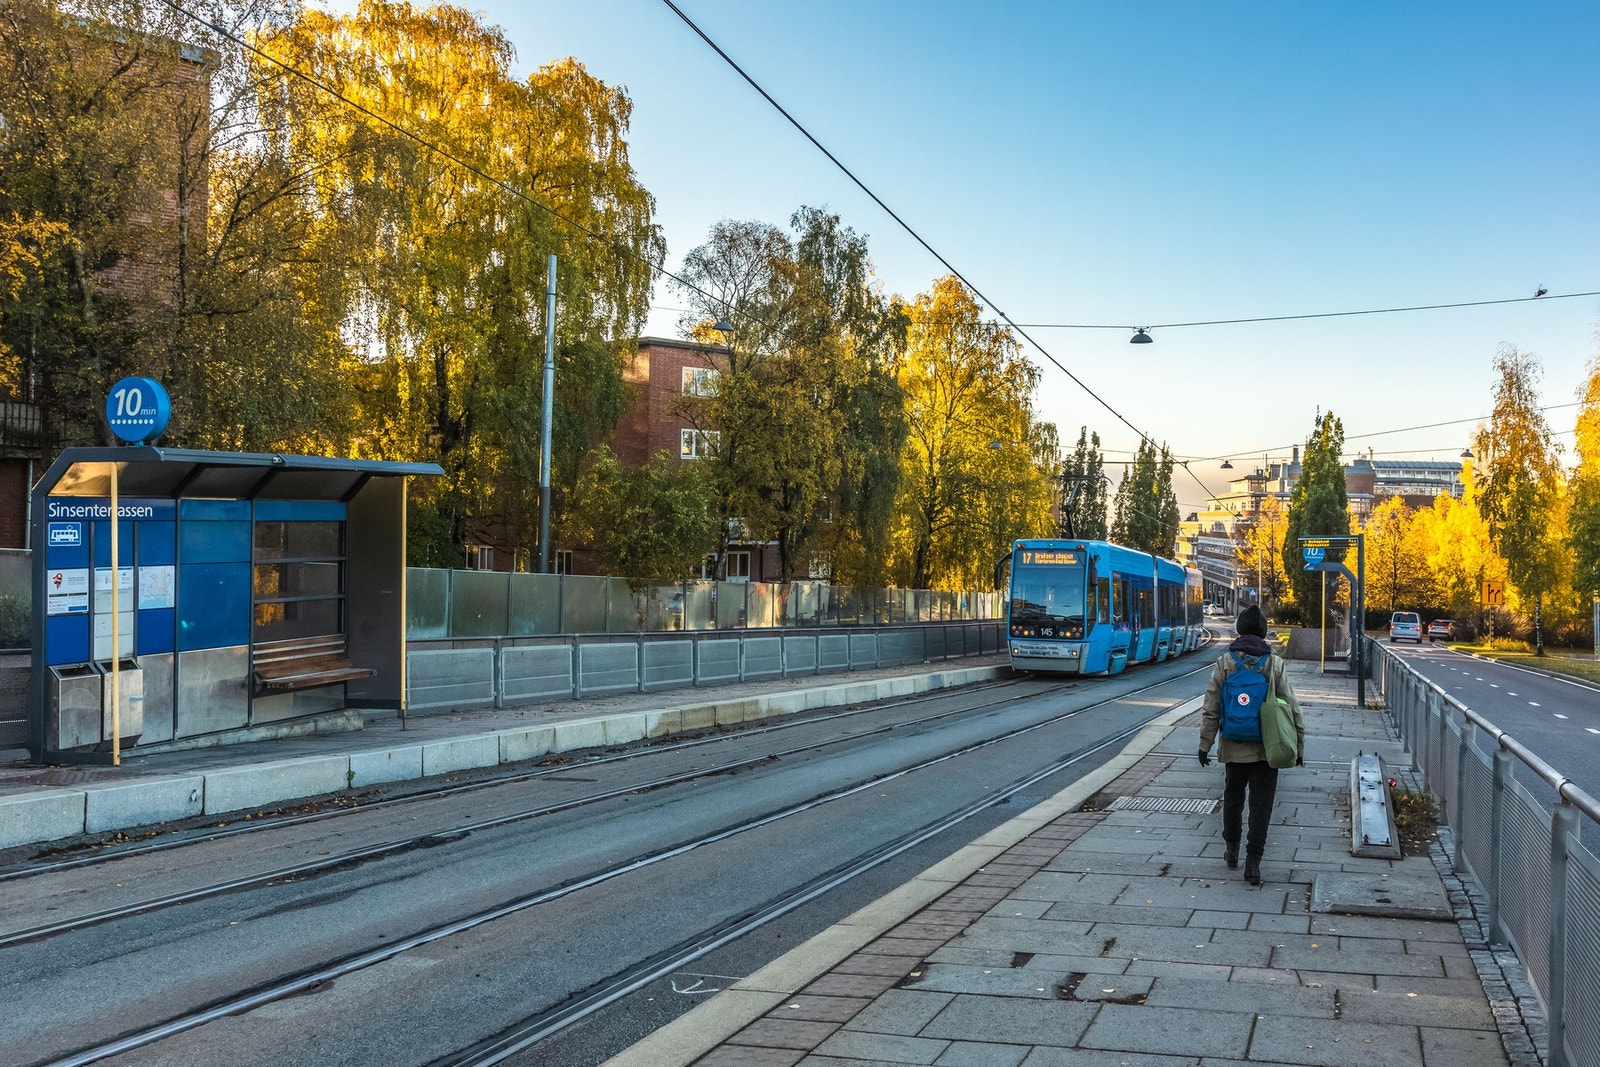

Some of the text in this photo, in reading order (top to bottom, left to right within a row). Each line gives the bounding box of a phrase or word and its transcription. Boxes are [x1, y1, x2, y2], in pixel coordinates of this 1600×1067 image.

[114, 388, 157, 417] 10 min
[48, 502, 153, 518] Sinsenterassen
[1022, 552, 1032, 564] 17
[1040, 628, 1053, 636] 145
